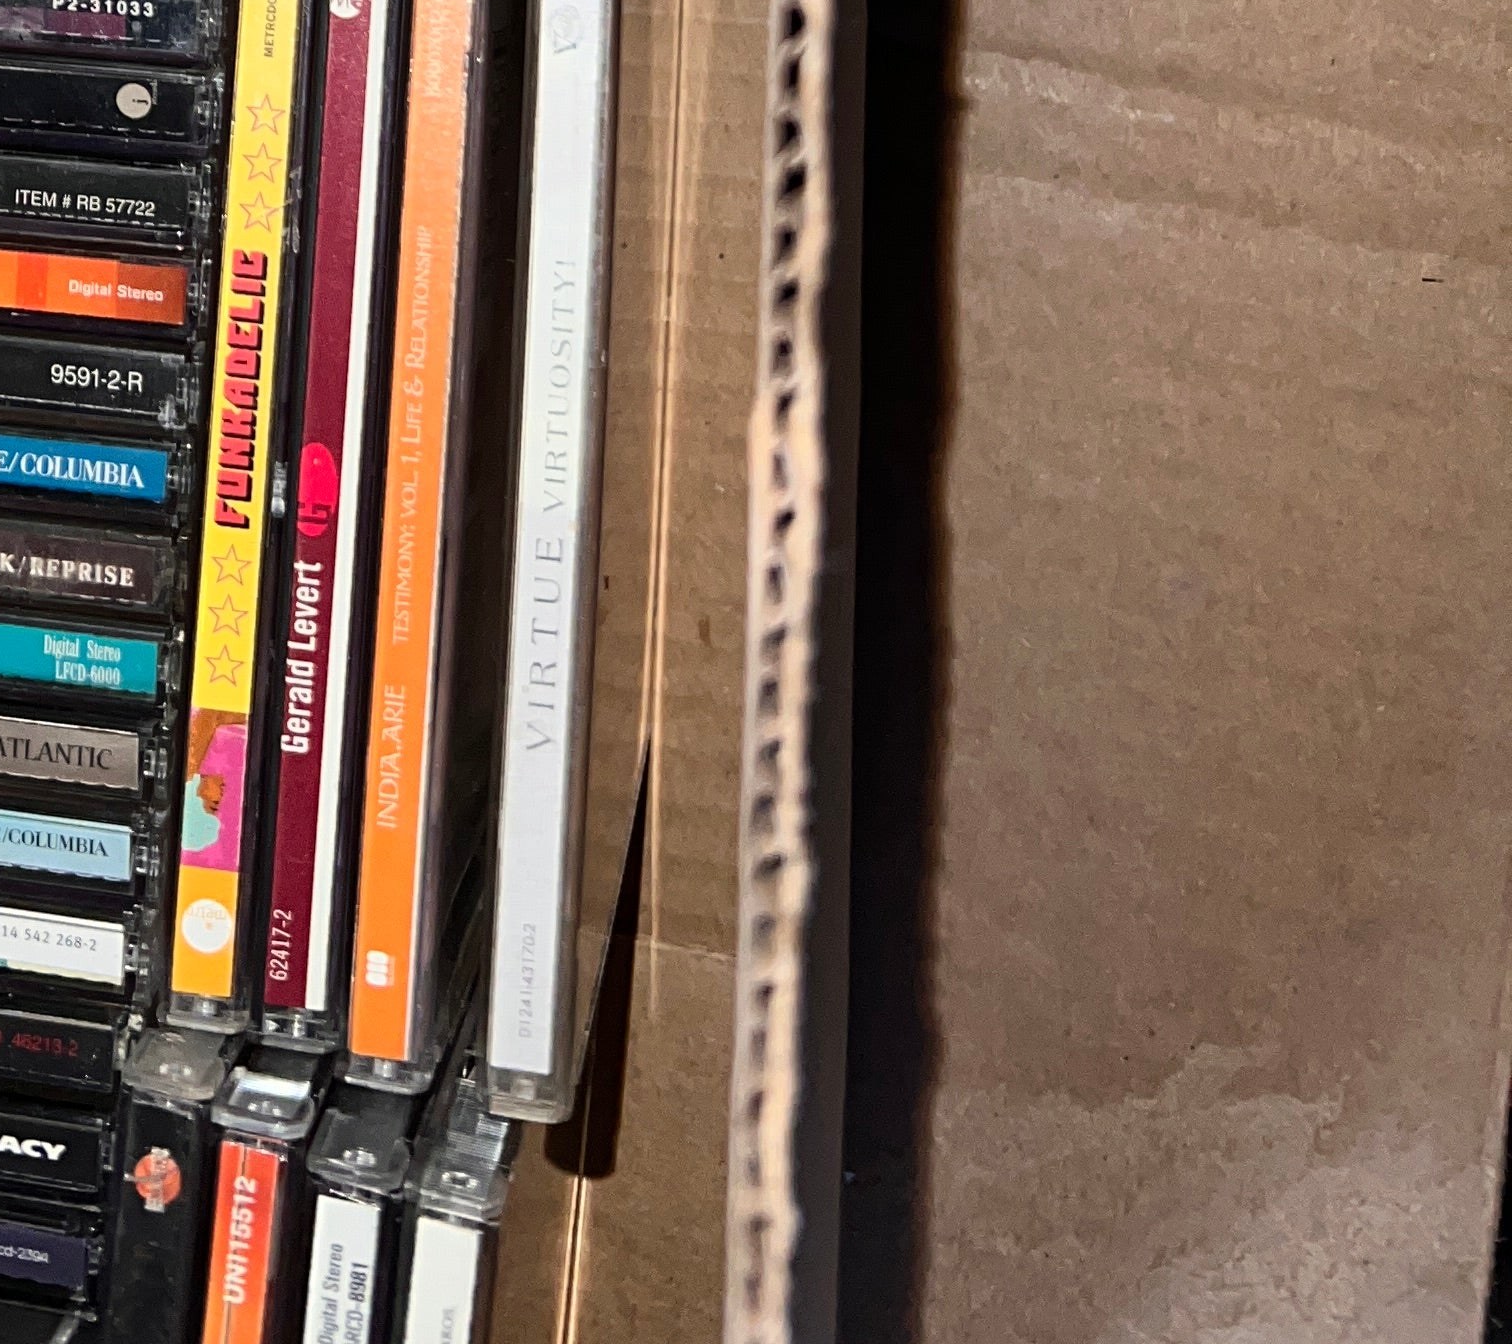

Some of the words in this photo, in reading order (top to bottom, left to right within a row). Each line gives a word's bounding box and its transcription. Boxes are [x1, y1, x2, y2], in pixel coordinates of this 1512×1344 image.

[50, 364, 143, 392] 9591-2-R
[214, 249, 268, 528] FUNKADELIC
[287, 560, 322, 652] Levert
[525, 535, 565, 752] VIRTUE
[281, 659, 314, 754] Gerald
[269, 909, 293, 982] 62417-2
